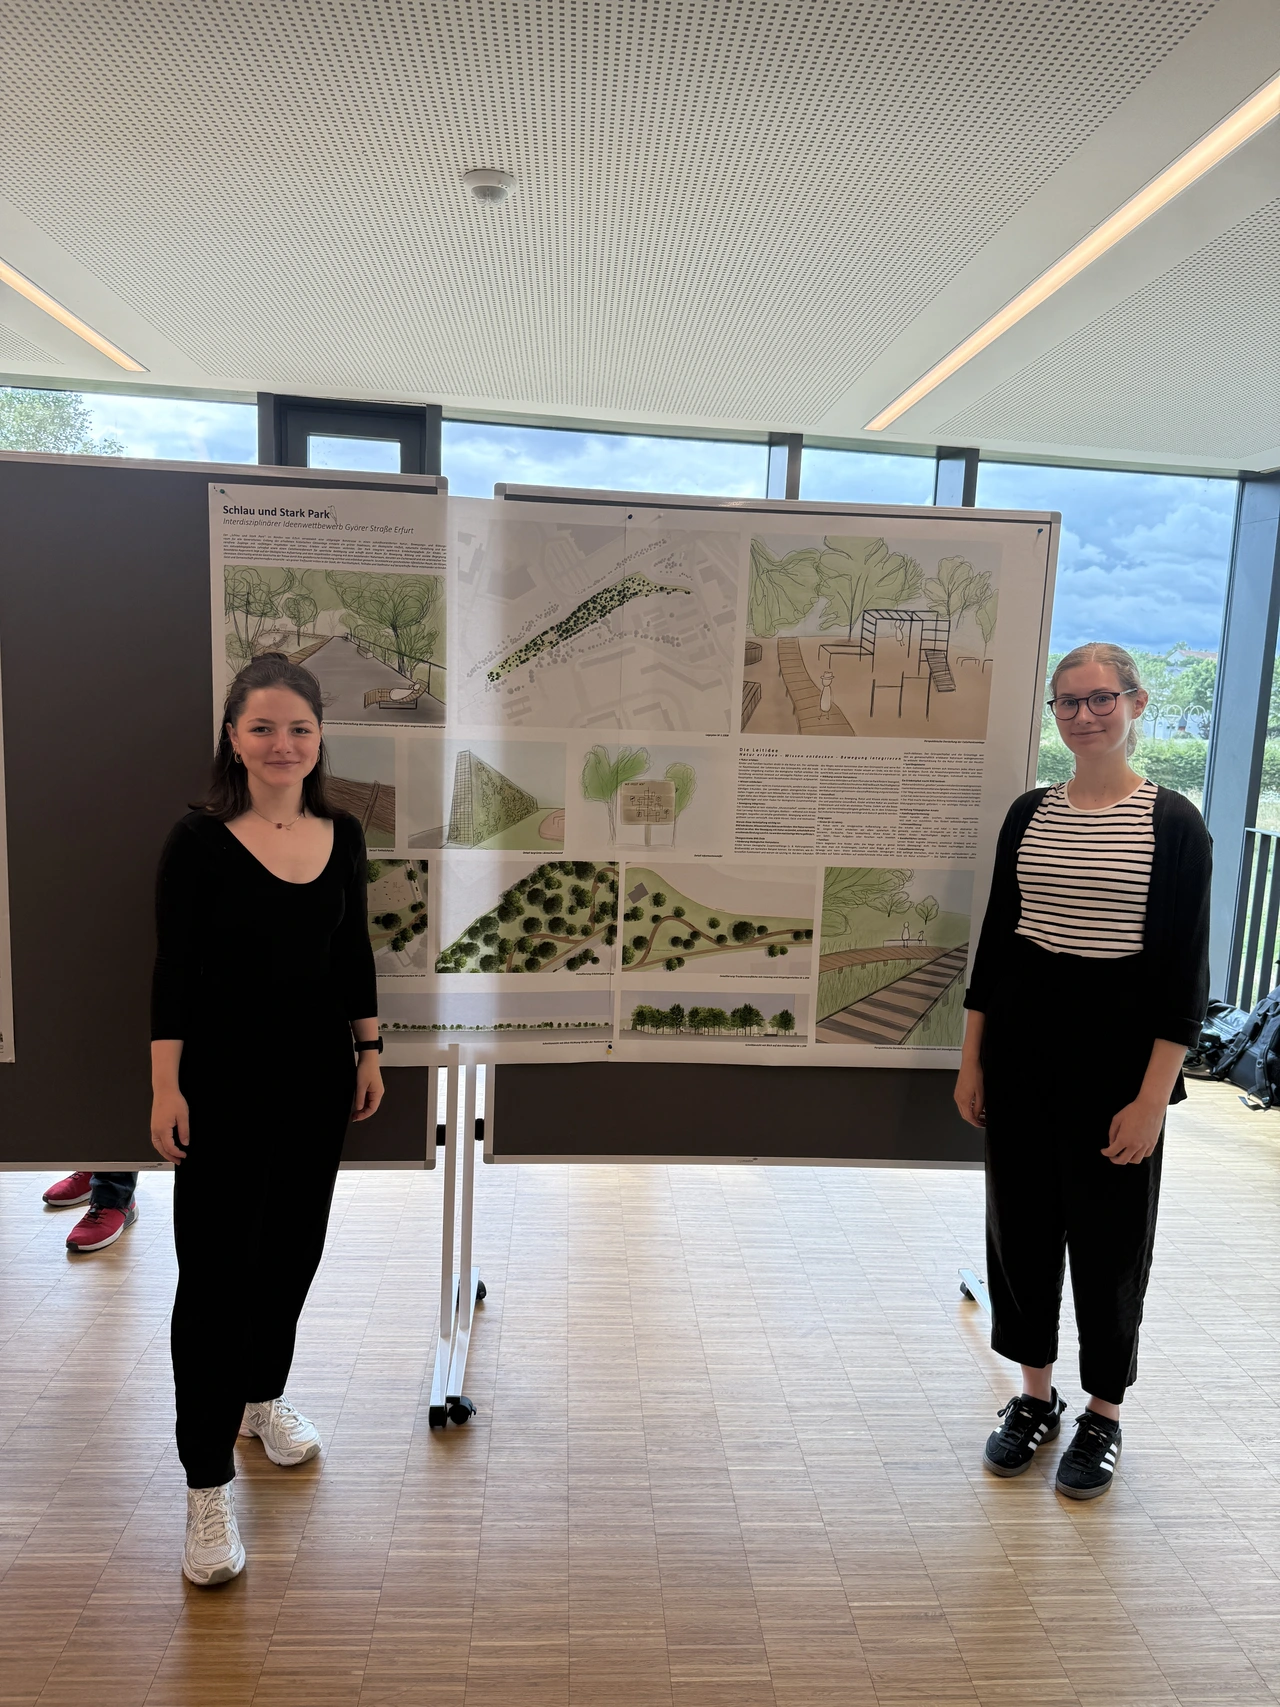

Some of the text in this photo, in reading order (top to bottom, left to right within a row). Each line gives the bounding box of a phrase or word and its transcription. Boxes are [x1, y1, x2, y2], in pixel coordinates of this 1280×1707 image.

[223, 505, 330, 519] Schlau und Stark Park
[223, 518, 282, 528] Interdisziplinärer
[283, 520, 344, 531] Ideenwettbewerb
[370, 524, 393, 534] Straße
[394, 526, 414, 535] Erfurt
[248, 1411, 269, 1428] N
